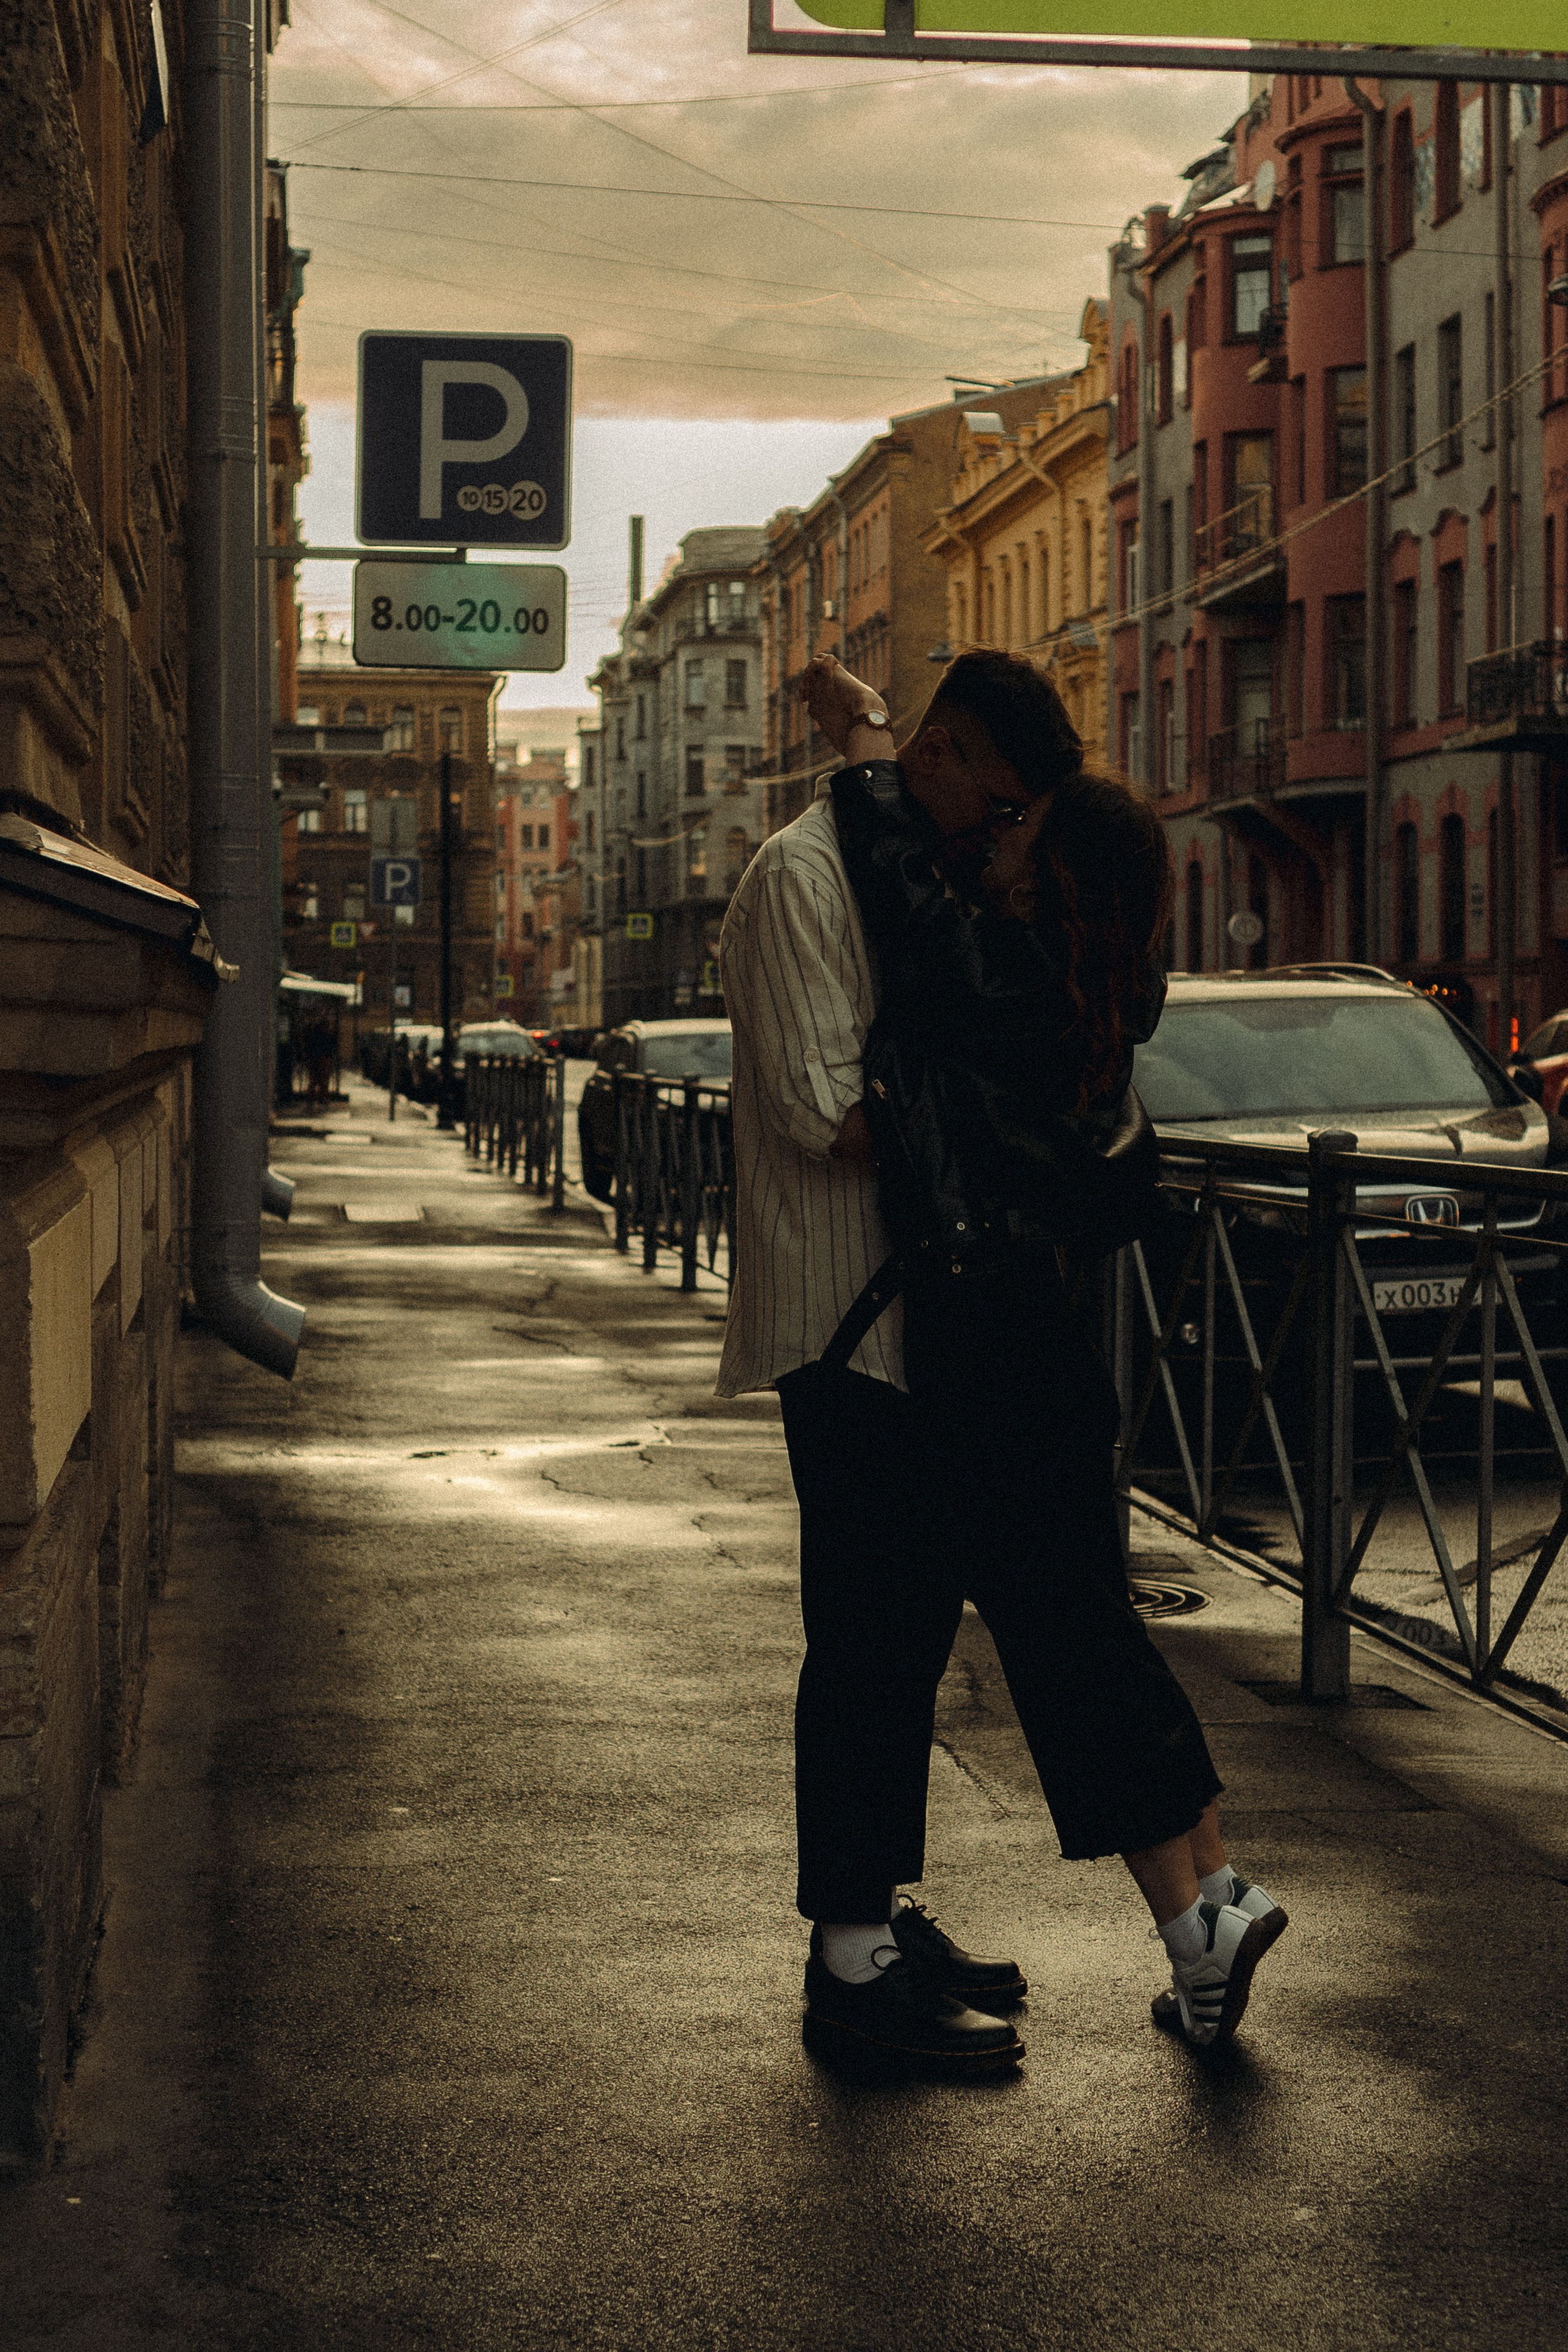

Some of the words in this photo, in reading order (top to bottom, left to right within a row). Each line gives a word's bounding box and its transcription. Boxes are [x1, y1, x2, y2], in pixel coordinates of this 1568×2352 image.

[419, 358, 530, 519] P
[462, 491, 479, 505] 10
[485, 490, 504, 508] 15
[513, 488, 543, 511] 20
[371, 595, 549, 635] 8.00-20.00
[385, 862, 411, 900] P
